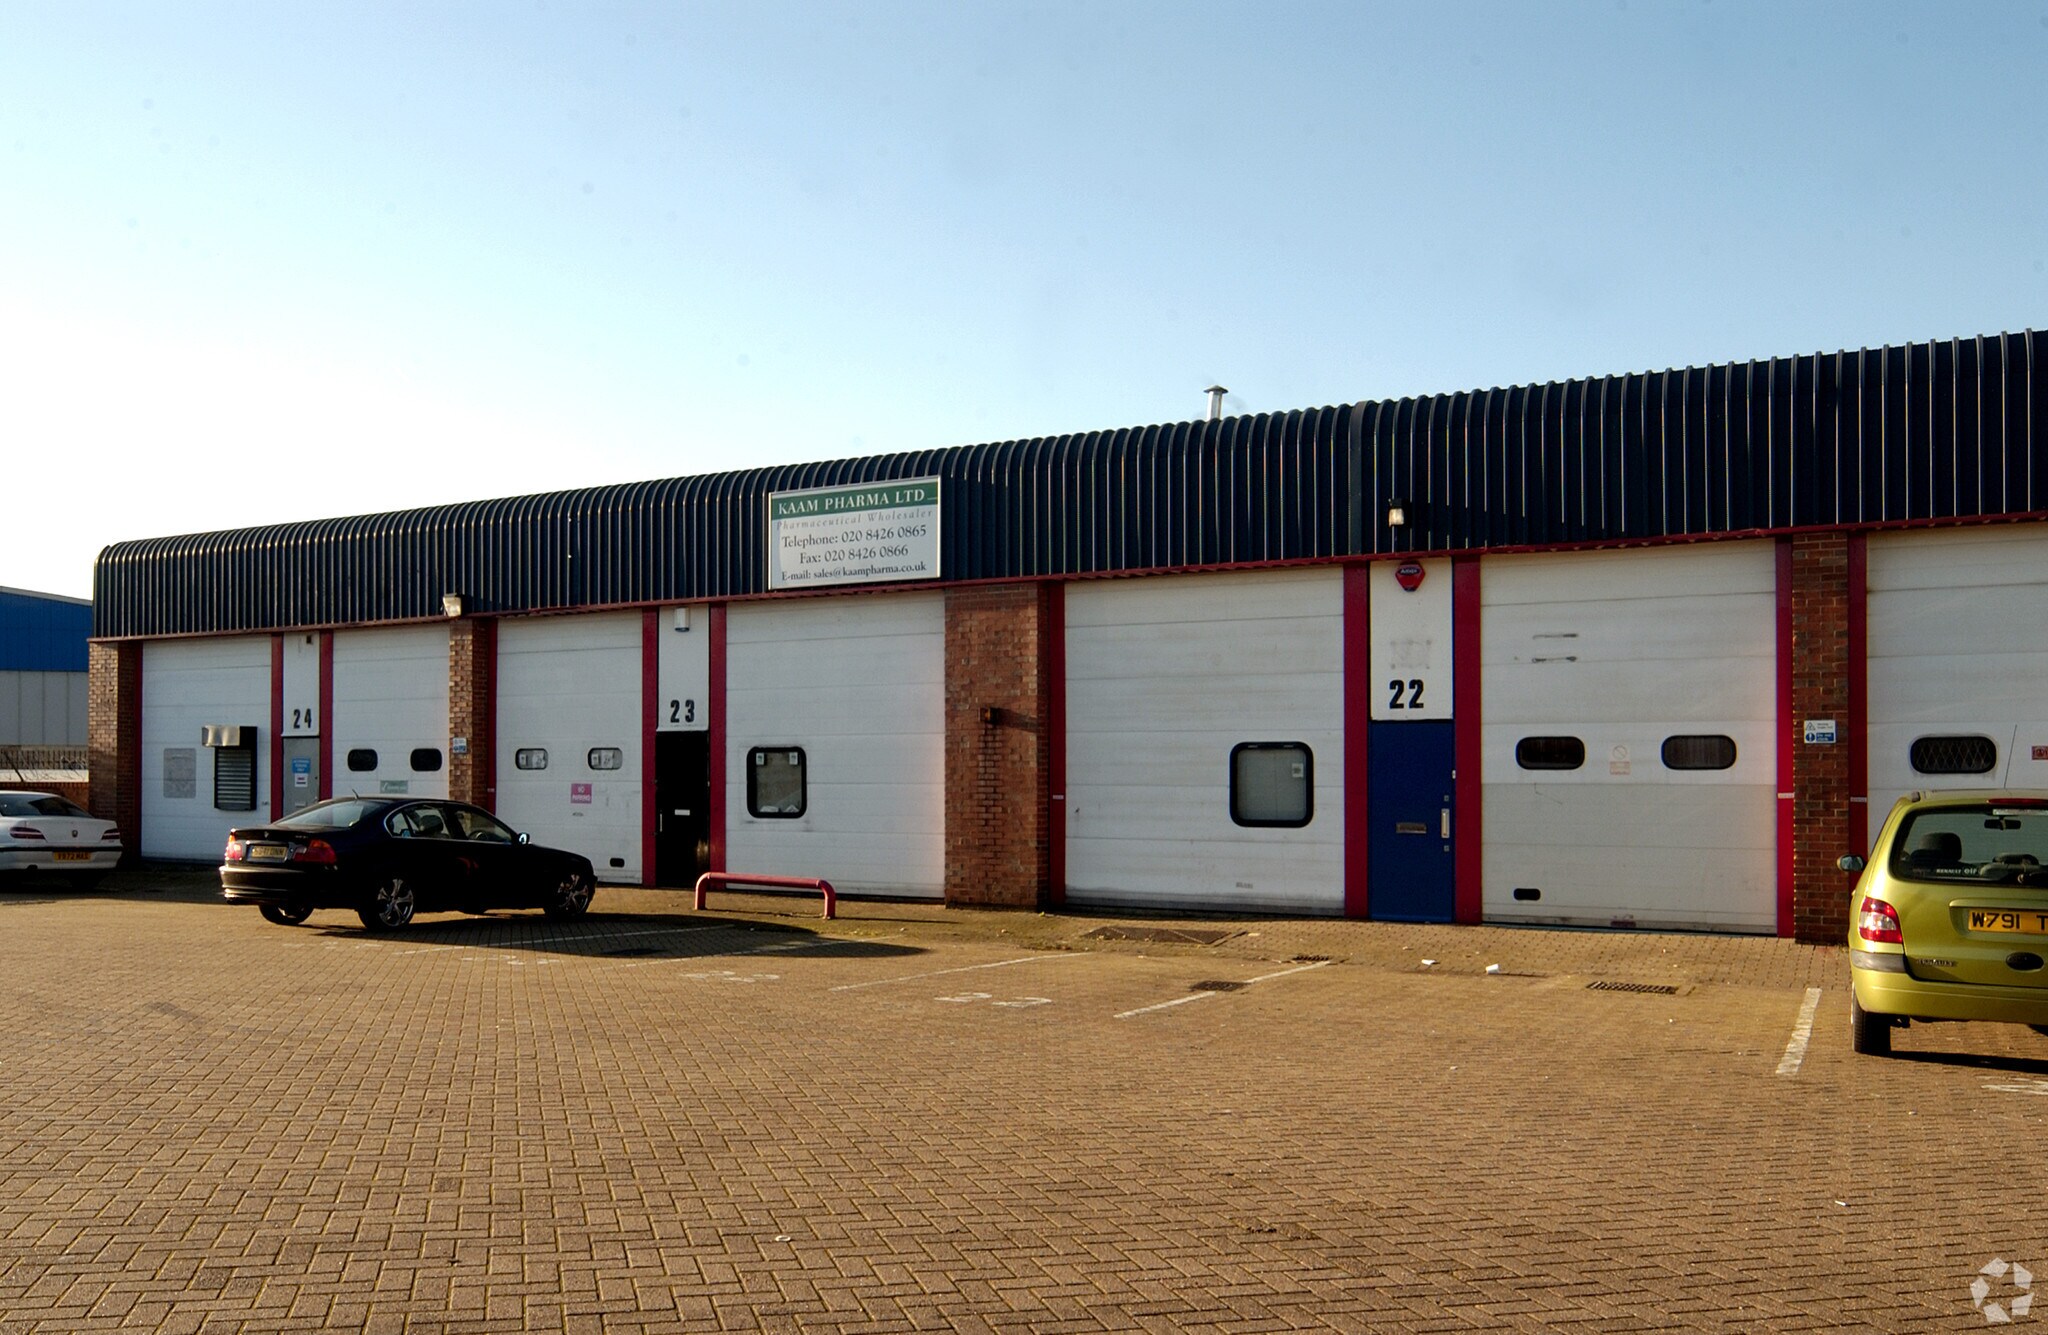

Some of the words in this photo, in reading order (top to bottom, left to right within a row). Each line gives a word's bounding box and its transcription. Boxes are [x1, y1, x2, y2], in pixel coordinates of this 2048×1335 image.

[778, 499, 818, 515] KAAM
[825, 493, 889, 511] PHARMA
[895, 489, 925, 504] LTD
[777, 514, 861, 530] Pharmaceutical
[868, 508, 933, 522] Wholesaler
[782, 534, 838, 549] Telephone:
[842, 530, 863, 543] 020
[866, 527, 894, 541] 8426
[898, 524, 927, 538] 0865
[799, 552, 821, 564] Fax:
[824, 549, 845, 562] 020
[849, 547, 876, 561] 8426
[879, 544, 909, 558] 0866
[782, 570, 811, 581] E-mail:
[813, 561, 927, 579] sales@kaampharma.co.uk
[1389, 679, 1424, 709] 22
[293, 708, 312, 729] 24
[670, 699, 695, 723] 23
[1972, 912, 2020, 929] W791
